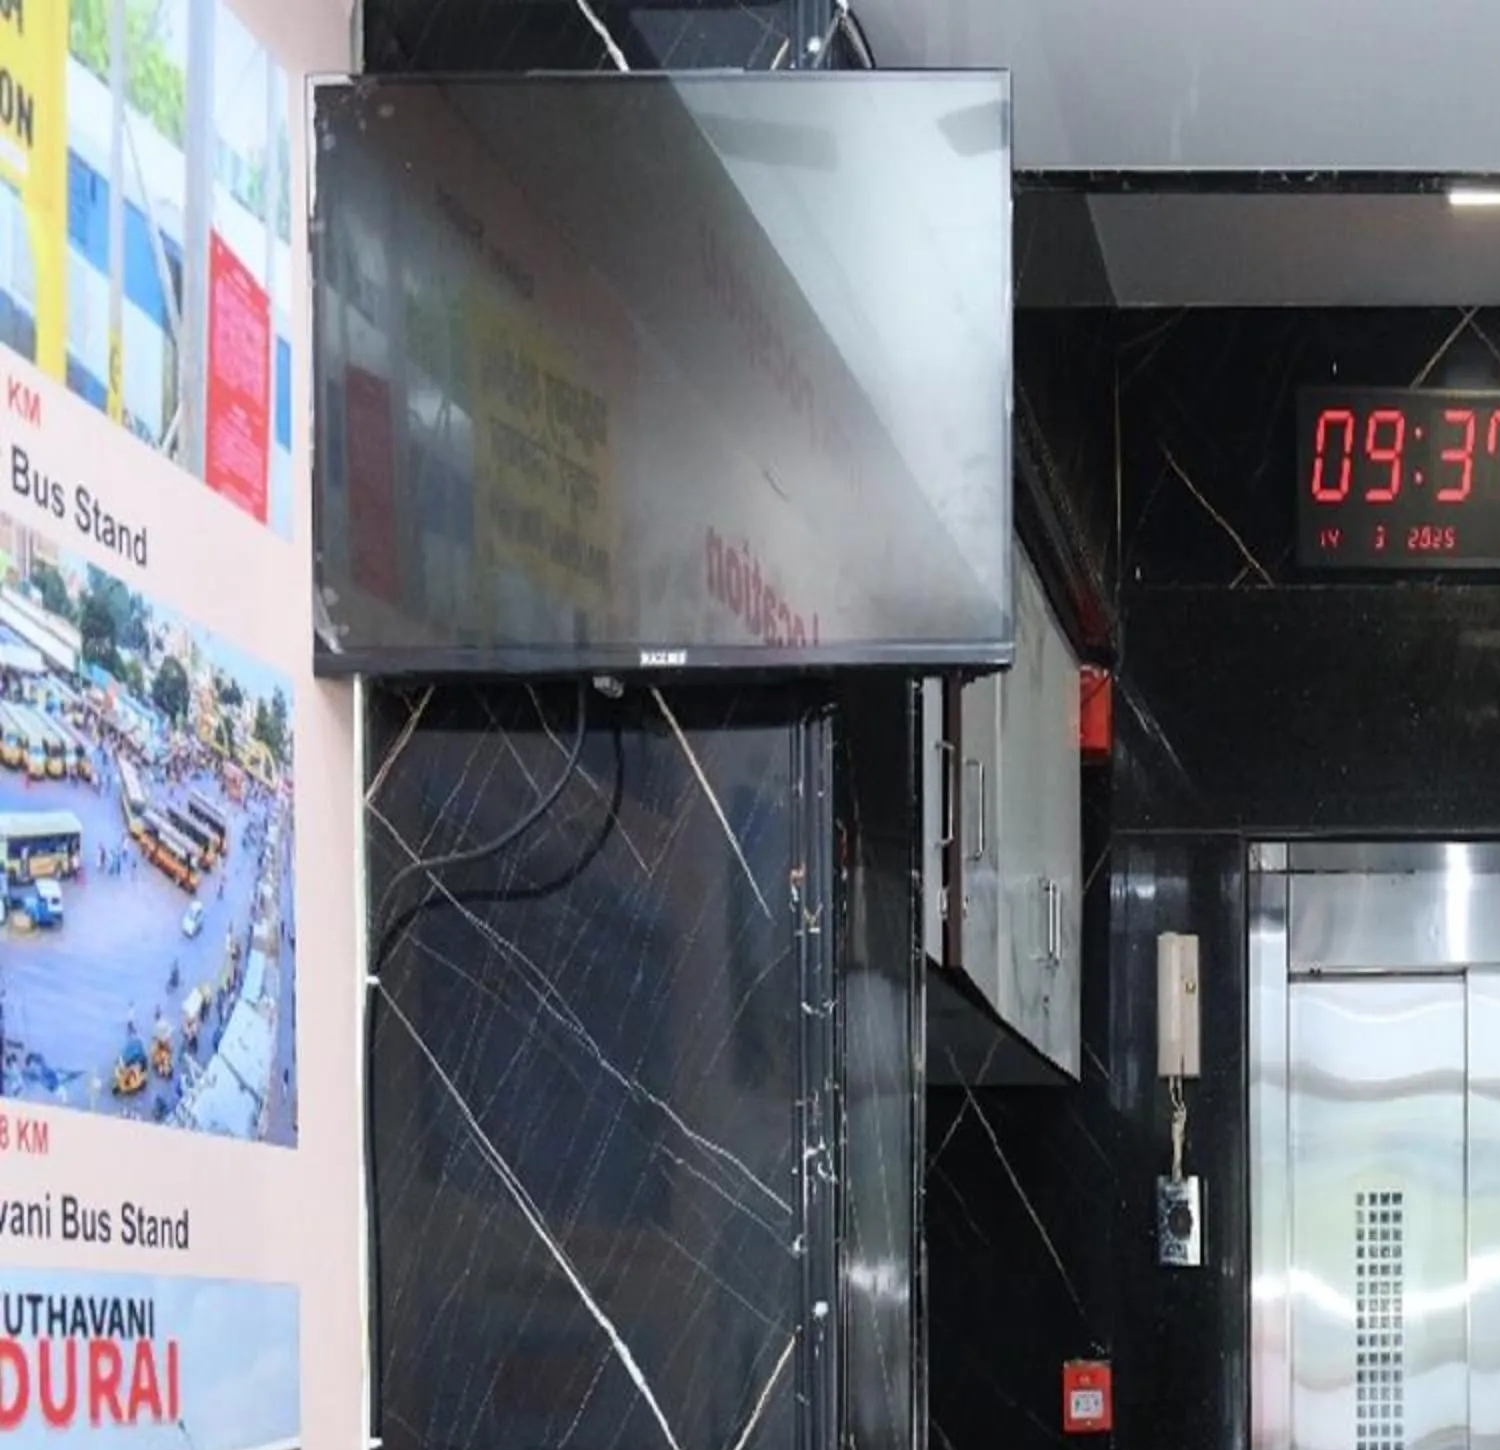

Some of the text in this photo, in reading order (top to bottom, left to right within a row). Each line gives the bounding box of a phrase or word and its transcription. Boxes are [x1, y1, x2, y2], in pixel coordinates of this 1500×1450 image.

[8, 374, 41, 427] KM
[11, 443, 147, 568] Bus Stand
[17, 1118, 49, 1154] KM
[62, 1194, 112, 1243] Bus
[121, 1201, 190, 1250] Stand
[4, 1293, 155, 1340] UTHAVANI
